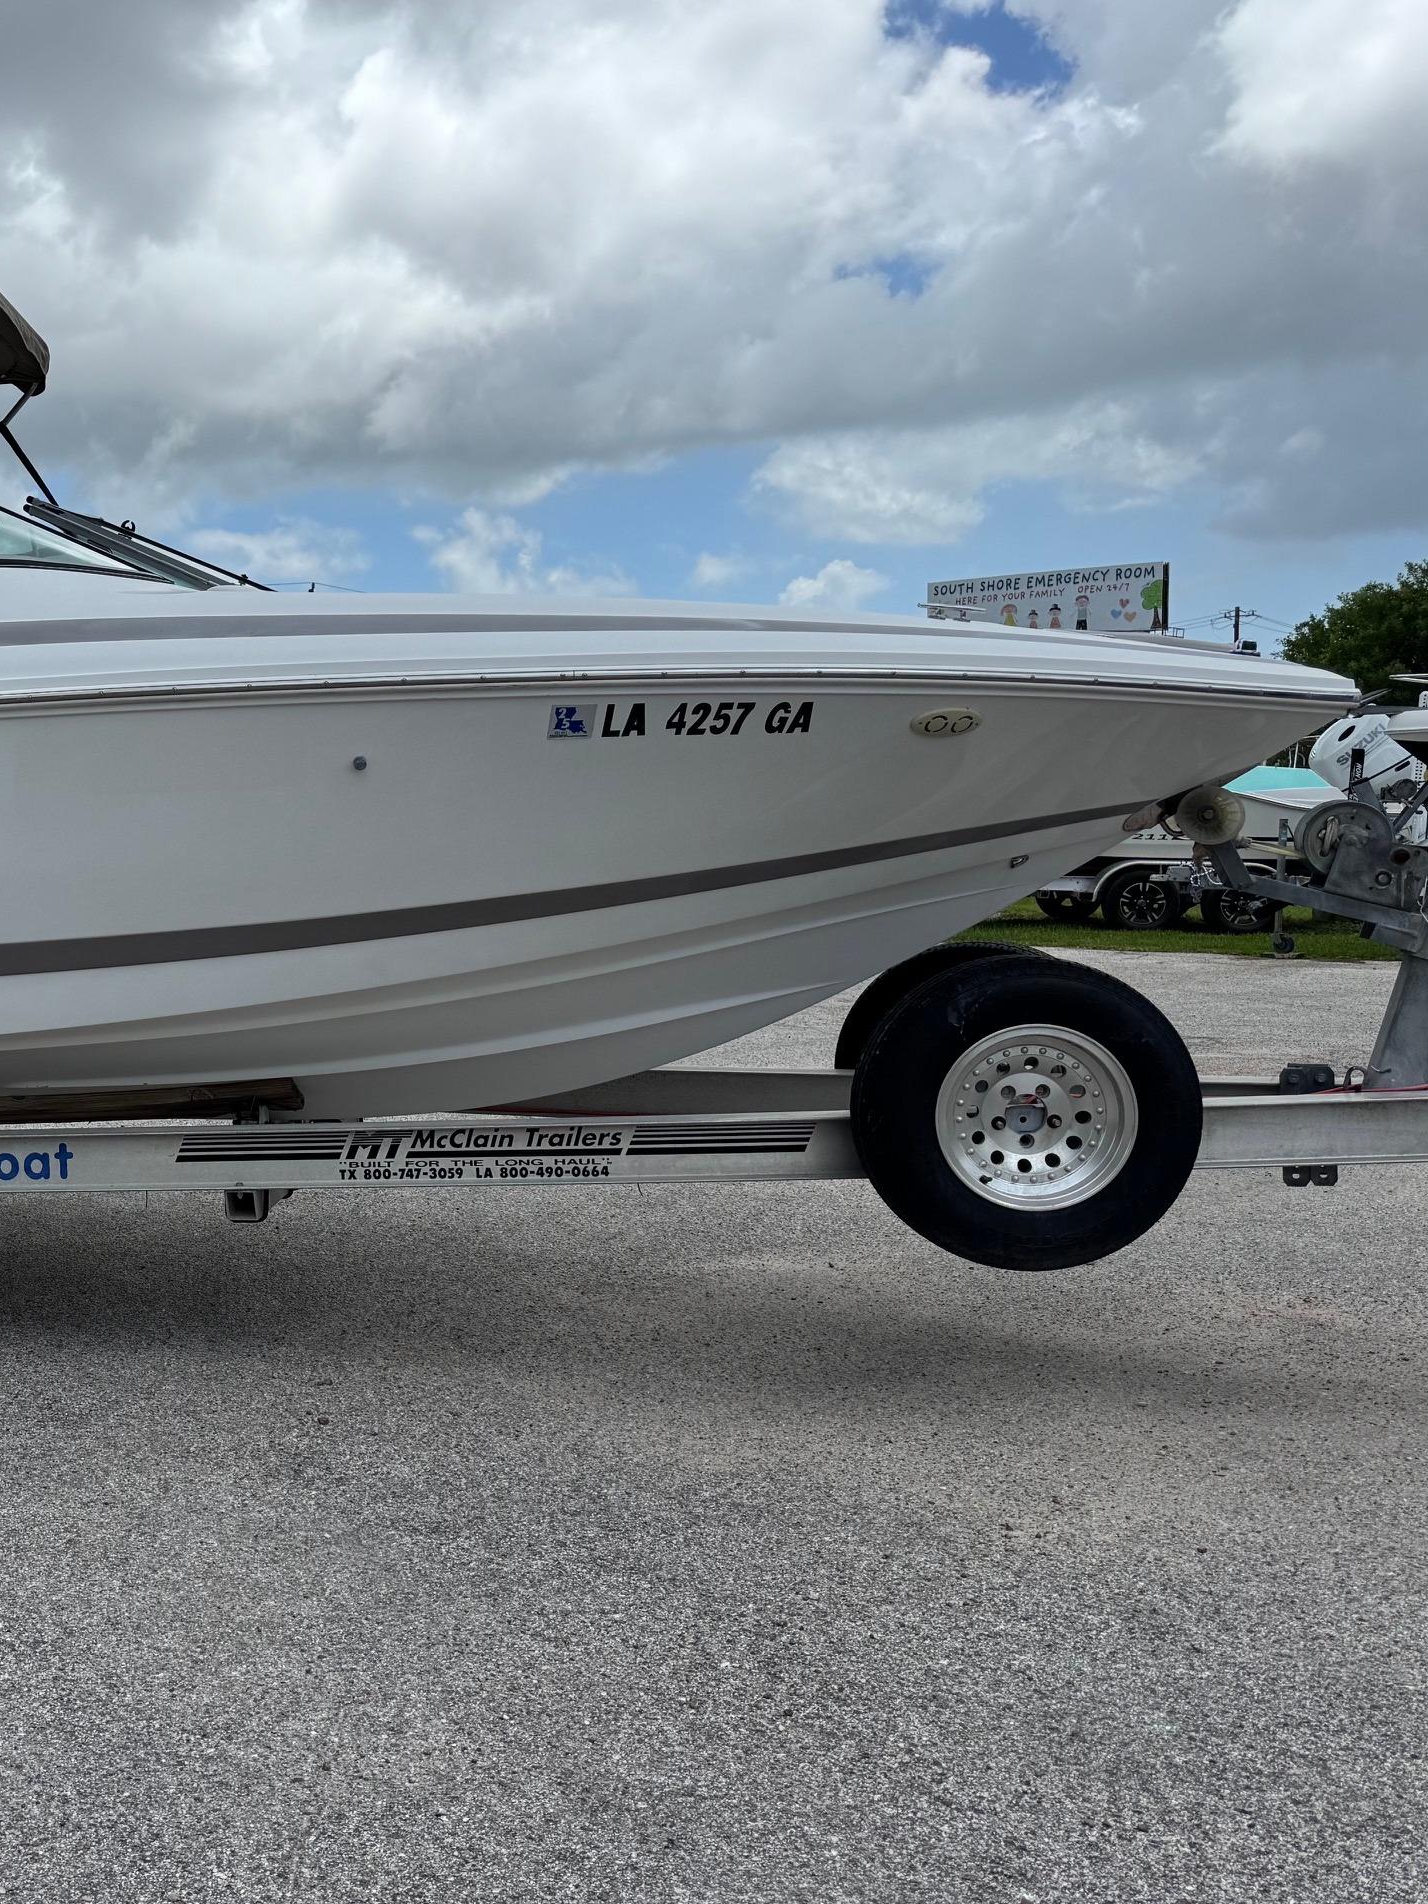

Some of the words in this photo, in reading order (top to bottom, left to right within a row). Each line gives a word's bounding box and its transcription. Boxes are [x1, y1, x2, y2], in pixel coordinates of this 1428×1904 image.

[933, 582, 974, 597] SOUTH
[980, 577, 1021, 592] SHORE
[1026, 569, 1110, 589] EMERGENCY
[1115, 565, 1155, 580] ROOM
[1077, 584, 1103, 593] OPEN
[1106, 583, 1130, 592] 24/7
[955, 595, 978, 606] HERE
[981, 594, 999, 603] FOR
[1001, 591, 1026, 601] YOUR
[1029, 587, 1065, 599] FAMILY
[601, 703, 646, 738] LA
[665, 702, 756, 736] 4257
[764, 701, 814, 734] GA
[410, 1128, 515, 1149] McClain
[526, 1126, 623, 1148] Trailers
[405, 1160, 440, 1168] FOR
[451, 1159, 485, 1167] THE
[494, 1158, 544, 1167] LONG
[339, 1169, 358, 1181] TX
[363, 1167, 464, 1180] 800-747-3059
[475, 1166, 494, 1179] LA
[499, 1165, 610, 1178] 800-490-0664
